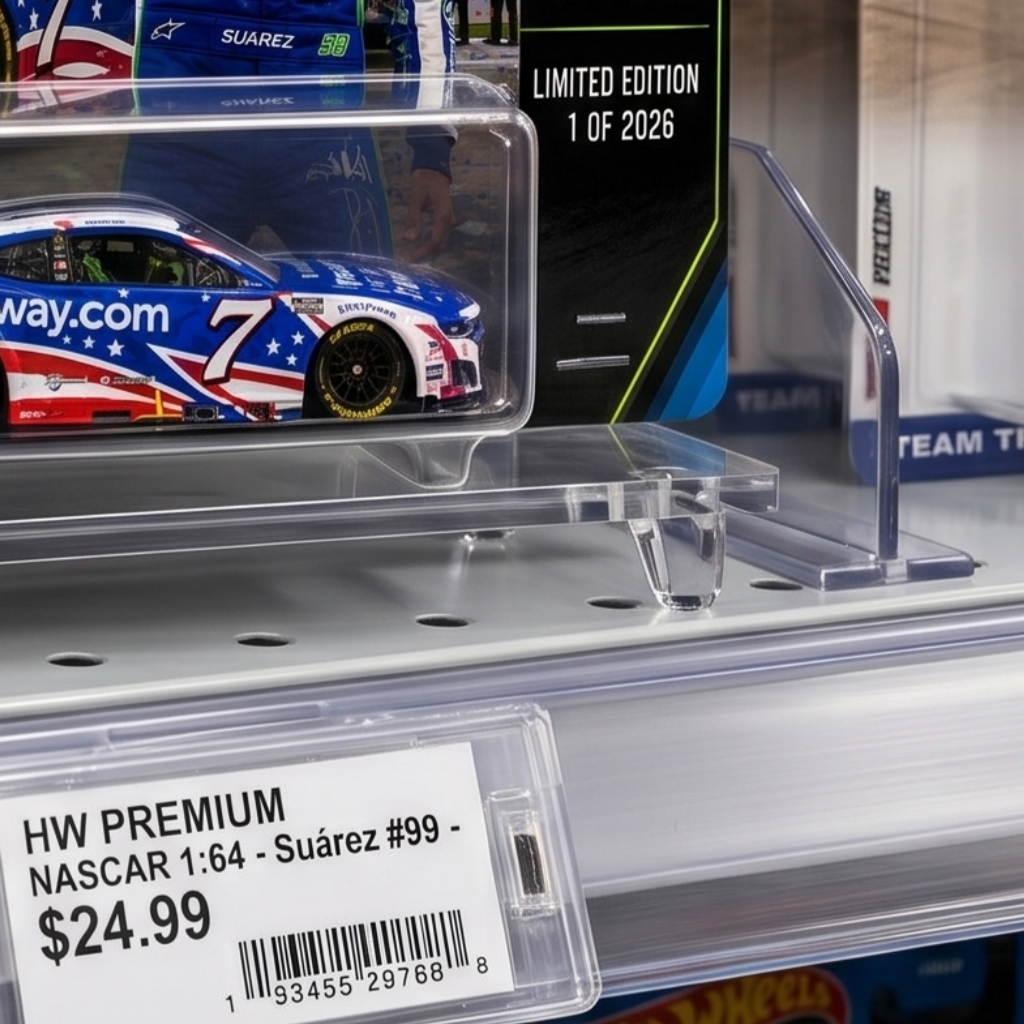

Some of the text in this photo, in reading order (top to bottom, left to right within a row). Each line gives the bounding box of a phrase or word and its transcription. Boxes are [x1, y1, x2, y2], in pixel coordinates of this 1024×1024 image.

[533, 63, 699, 100] LIMITED EDITION
[567, 108, 675, 143] 1 OF 2026
[203, 297, 274, 386] 7
[898, 429, 983, 460] TEAM
[23, 786, 288, 855] HW PREMIUM
[29, 849, 171, 898] NASCAR
[179, 840, 246, 877] 1:64
[274, 822, 380, 865] Suárez
[386, 814, 440, 850] #99
[38, 888, 212, 966] $24.99
[224, 956, 490, 1014] 1 93455 29768 8
